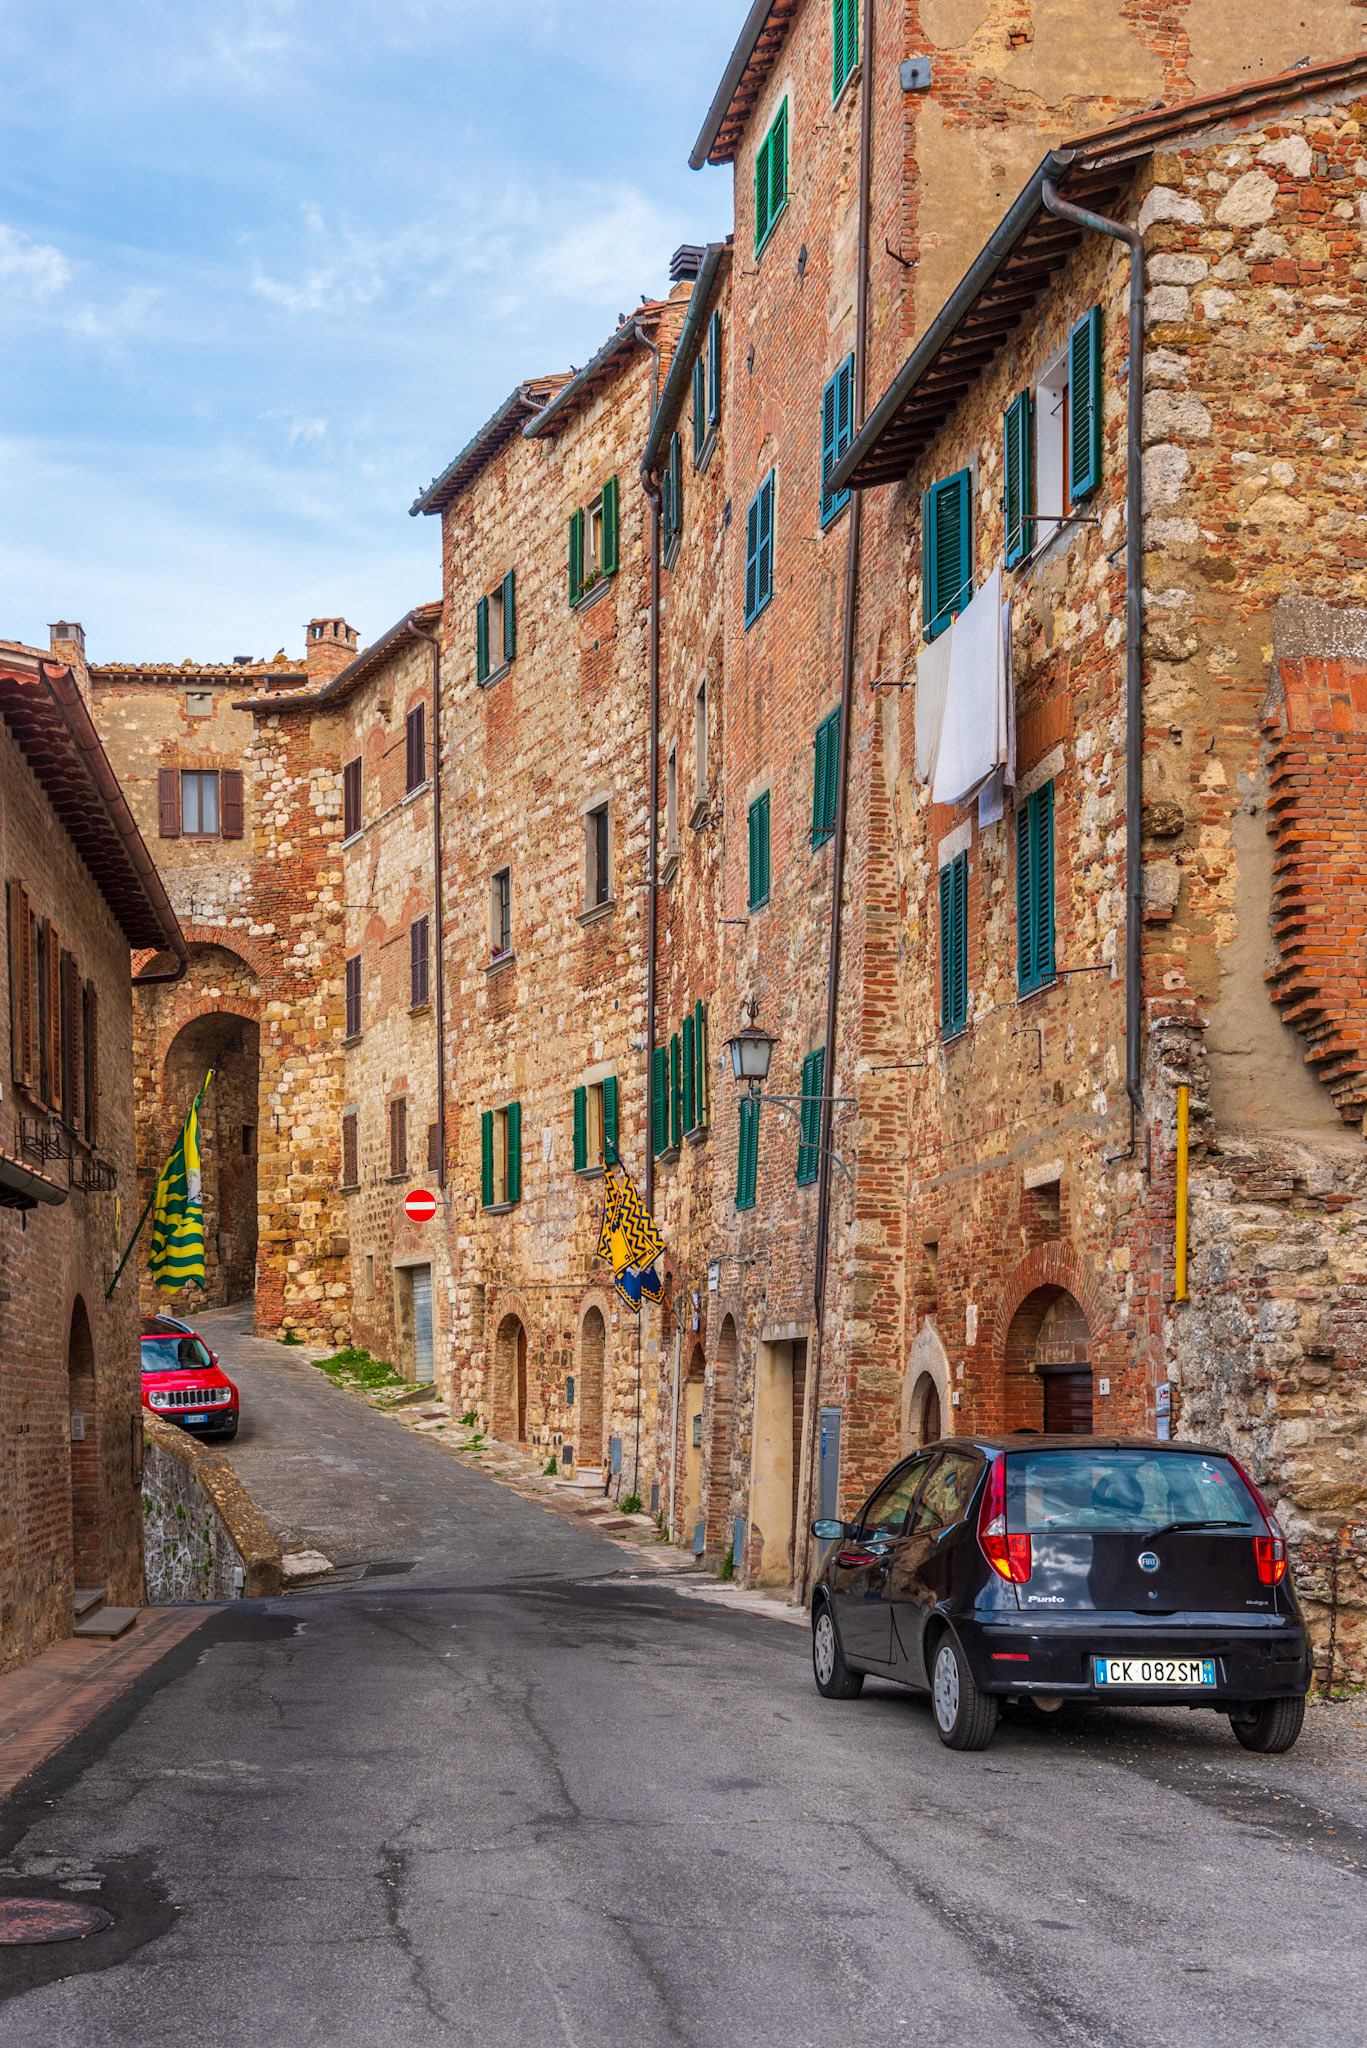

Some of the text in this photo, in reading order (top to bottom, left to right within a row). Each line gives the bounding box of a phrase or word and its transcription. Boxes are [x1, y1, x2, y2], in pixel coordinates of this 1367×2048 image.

[1141, 1557, 1156, 1566] FIAT
[1027, 1595, 1065, 1603] Punto
[1110, 1662, 1133, 1681] CK
[1141, 1662, 1201, 1682] 082SM
